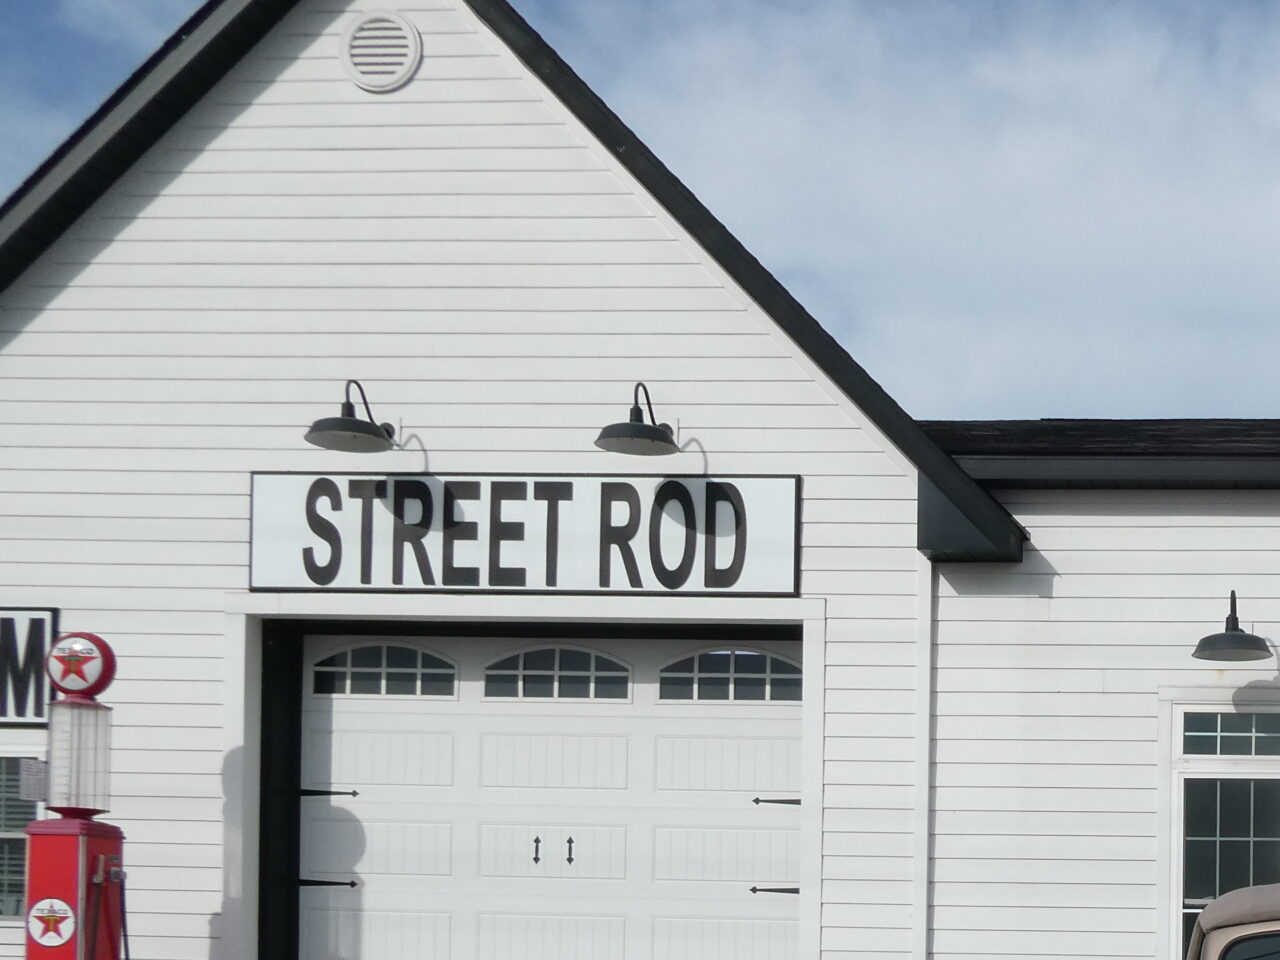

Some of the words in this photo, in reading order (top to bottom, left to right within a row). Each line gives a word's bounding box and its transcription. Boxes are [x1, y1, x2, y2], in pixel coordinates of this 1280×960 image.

[302, 477, 573, 587] STREET
[599, 479, 747, 590] ROD
[57, 647, 94, 655] TECO
